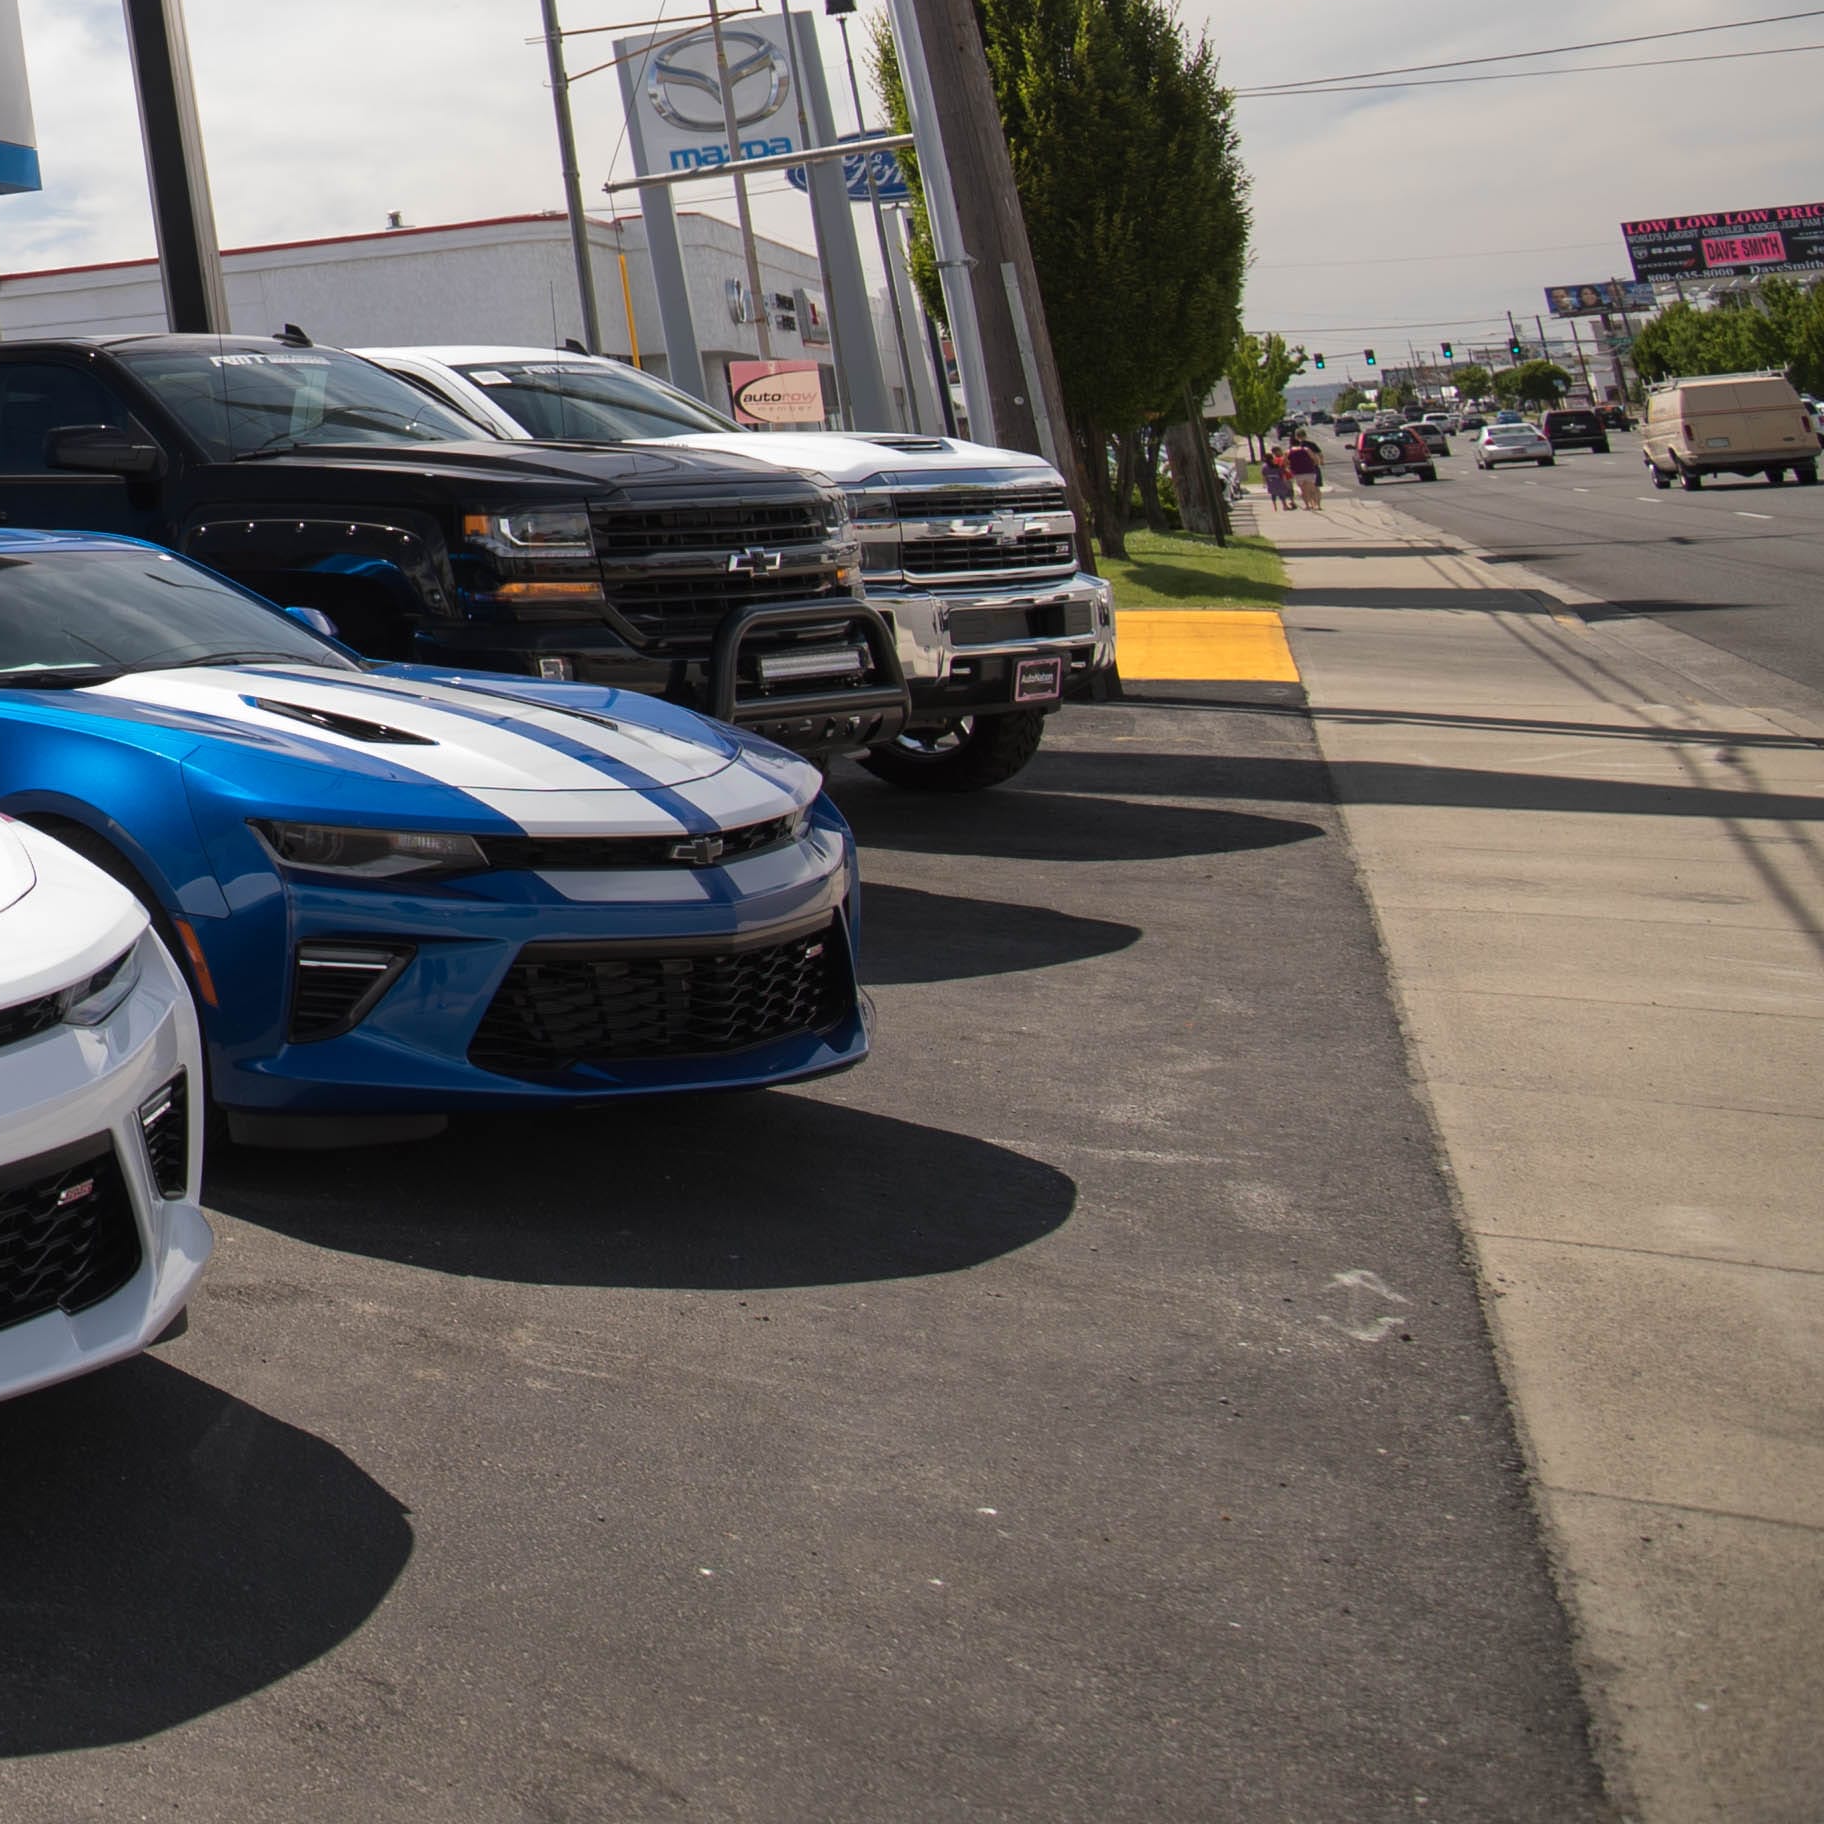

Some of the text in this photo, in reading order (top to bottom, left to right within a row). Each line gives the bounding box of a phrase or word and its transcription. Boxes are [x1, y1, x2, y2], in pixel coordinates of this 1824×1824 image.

[1626, 220, 1669, 235] LOW
[1674, 215, 1718, 230] LOW
[1724, 210, 1769, 225] LOW
[1651, 244, 1692, 254] RAM
[1706, 235, 1782, 261] DAVE SMITH
[743, 392, 818, 403] autorow
